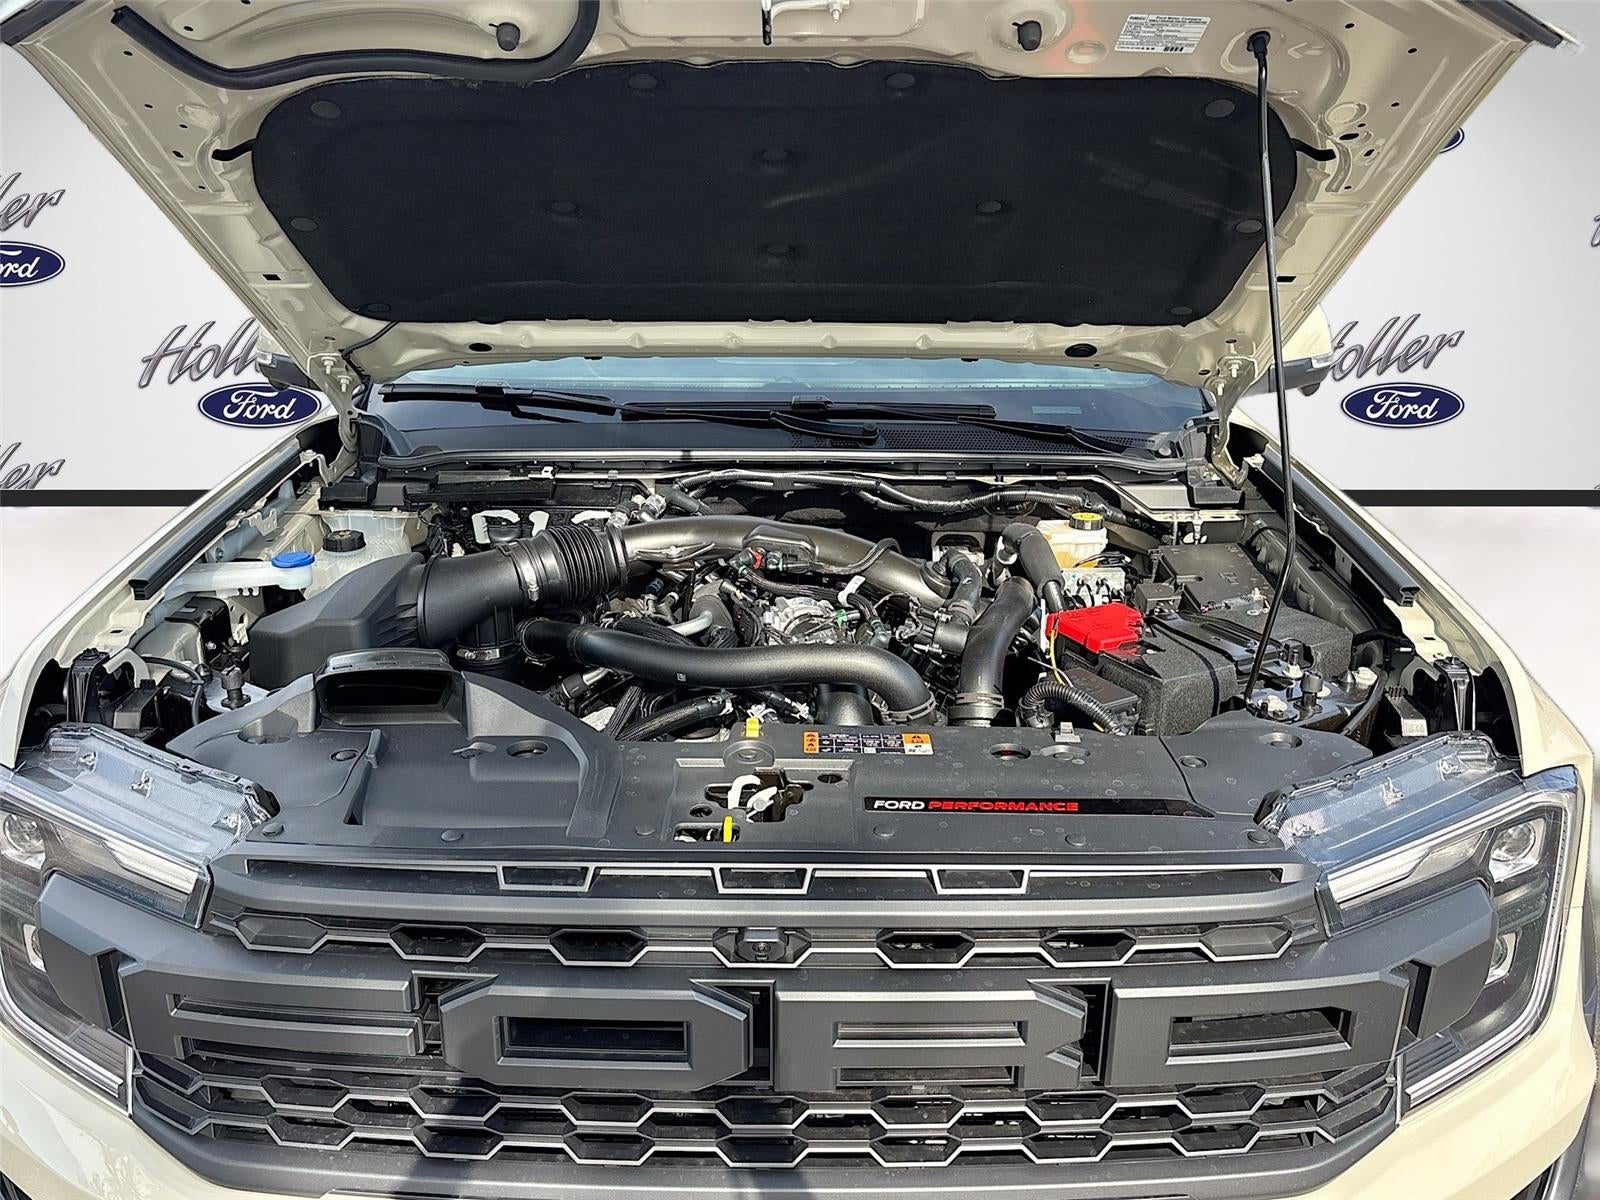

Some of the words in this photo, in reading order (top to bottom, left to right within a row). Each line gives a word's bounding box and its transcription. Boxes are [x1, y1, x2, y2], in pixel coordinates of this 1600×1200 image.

[138, 317, 260, 388] Holl
[223, 390, 297, 420] Ford
[1366, 390, 1440, 420] Ford
[873, 800, 926, 810] FORD
[928, 801, 1079, 811] PERFORMANCE
[118, 962, 1408, 1091] FORD
